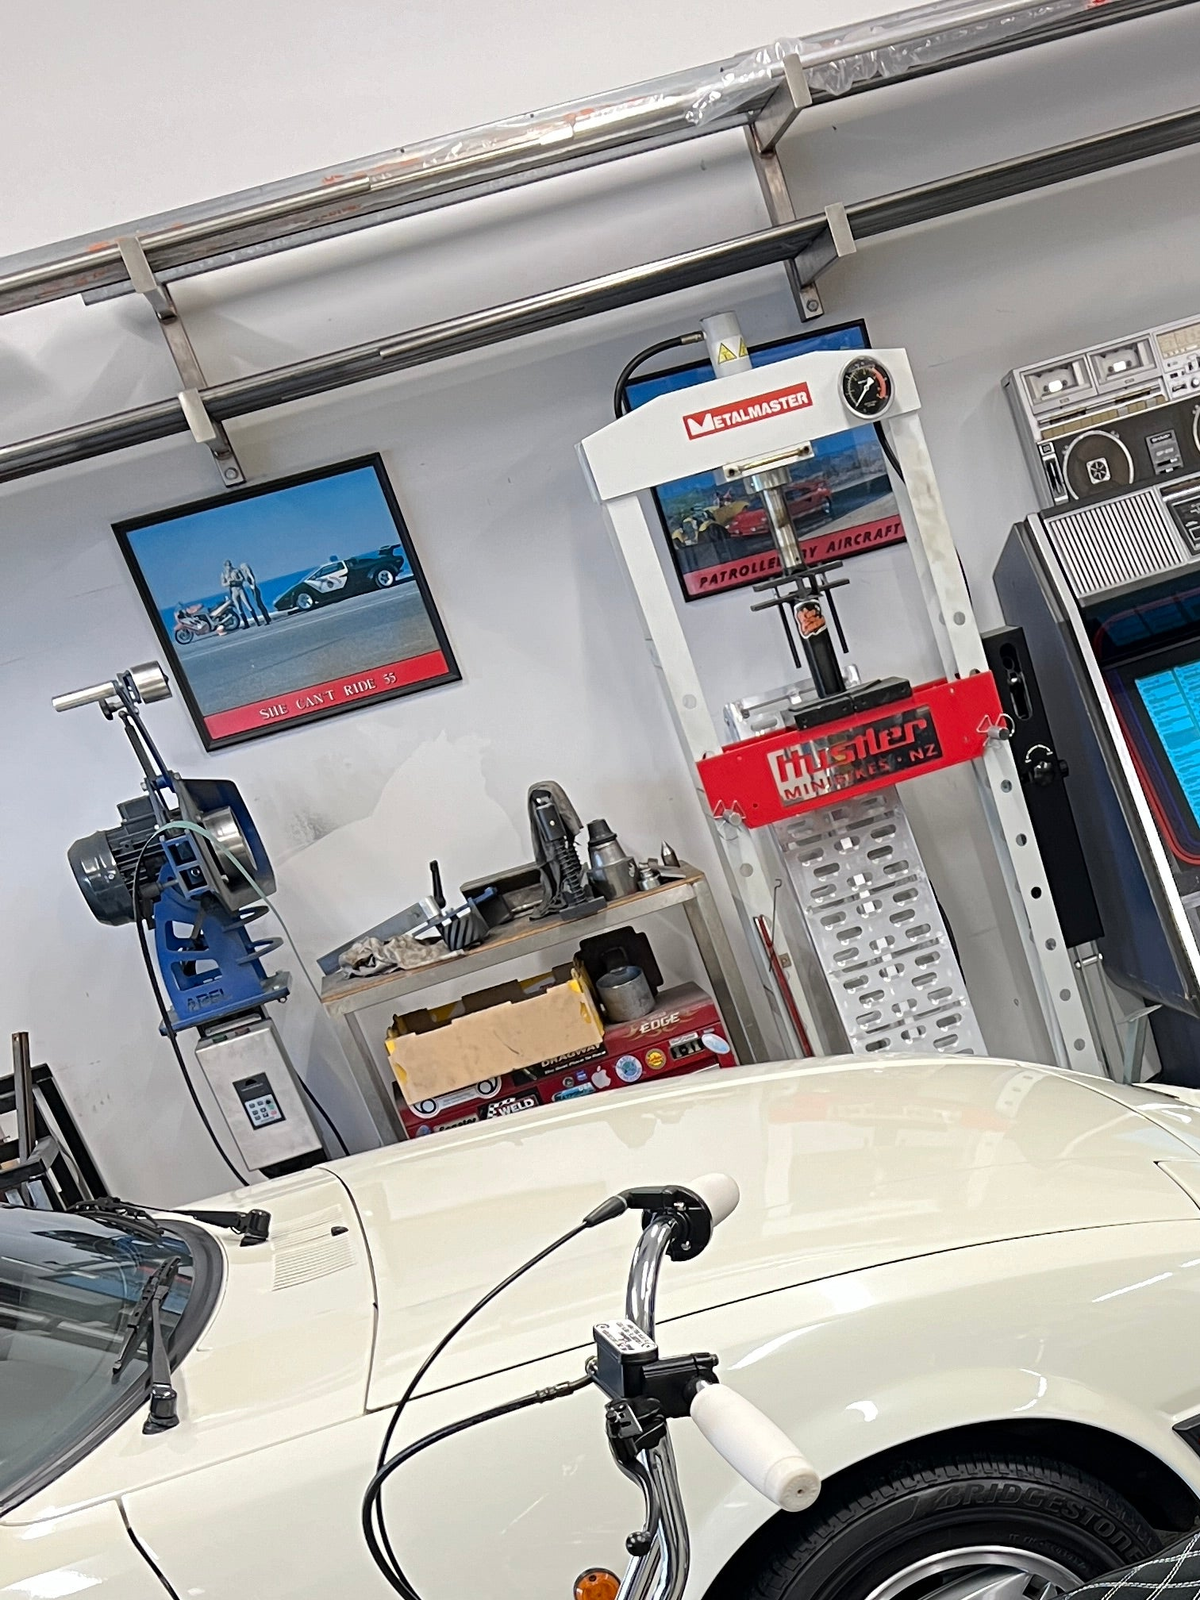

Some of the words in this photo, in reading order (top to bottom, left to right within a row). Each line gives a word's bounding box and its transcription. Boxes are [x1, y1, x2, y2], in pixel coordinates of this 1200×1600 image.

[687, 391, 809, 436] METALMASTER
[700, 556, 782, 588] PATROLLE
[826, 523, 901, 553] AIRCRAFT
[259, 704, 288, 720] SHE
[296, 690, 335, 710] CAN'T
[343, 678, 377, 696] RIDE
[383, 672, 397, 685] 55
[776, 718, 927, 783] Hustler
[909, 744, 938, 761] NZ
[639, 1012, 680, 1034] EDGE
[499, 1098, 535, 1116] WELD
[935, 1483, 1149, 1564] BRIDGESTONE
